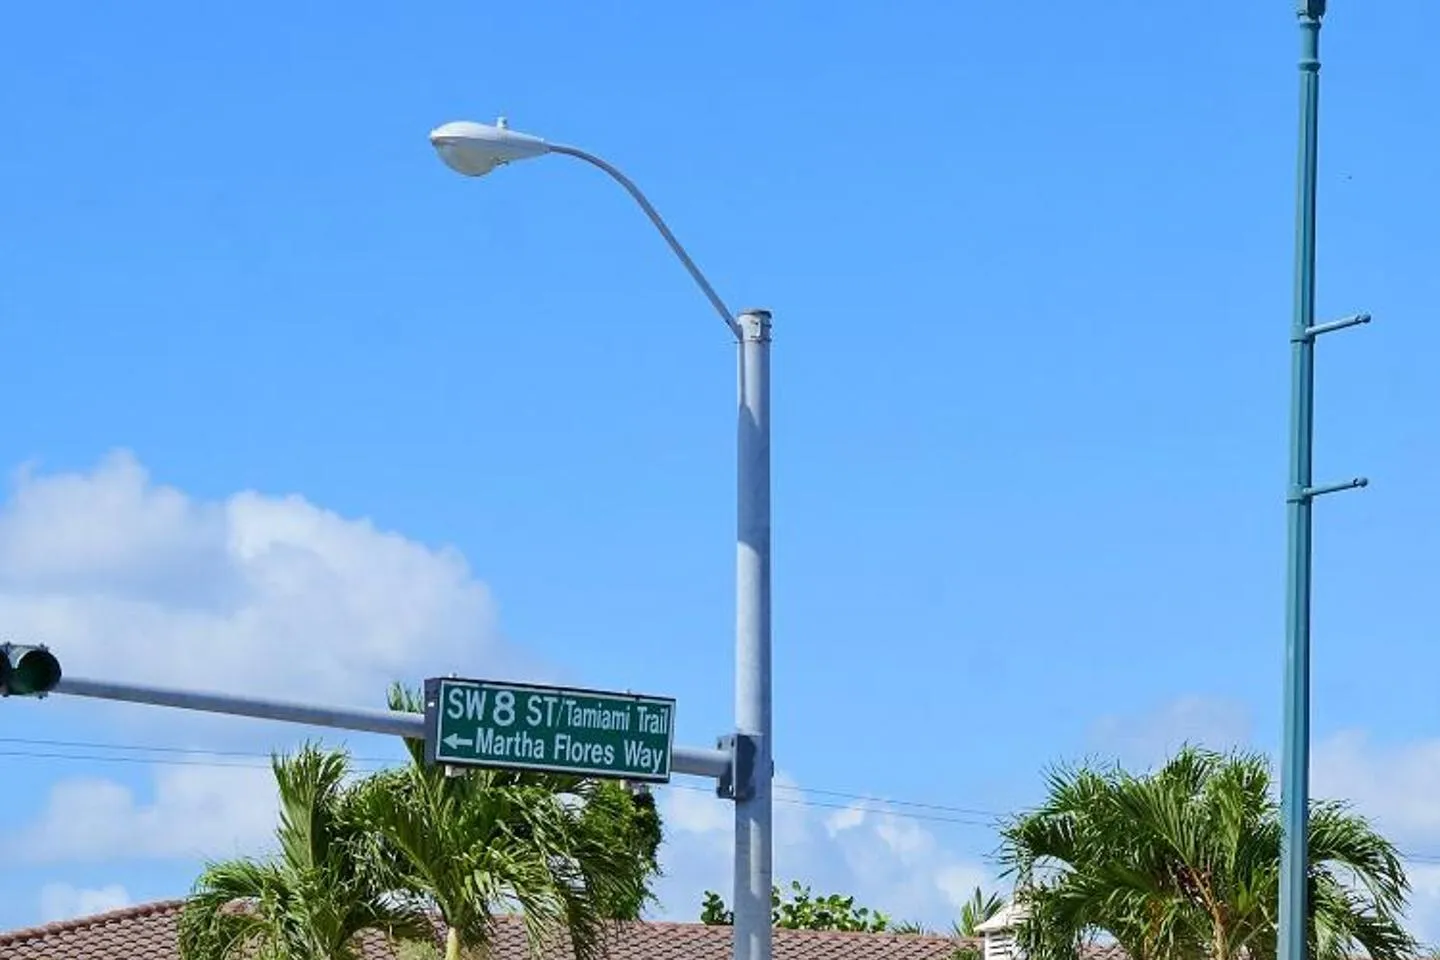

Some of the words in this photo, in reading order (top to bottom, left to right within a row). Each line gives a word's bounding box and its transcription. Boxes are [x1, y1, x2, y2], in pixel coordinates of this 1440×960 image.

[447, 688, 487, 721] SW
[493, 690, 516, 727] 8
[637, 706, 669, 735] Trail
[475, 727, 545, 759] Martha
[553, 733, 615, 765] Flores
[623, 740, 664, 773] Way
